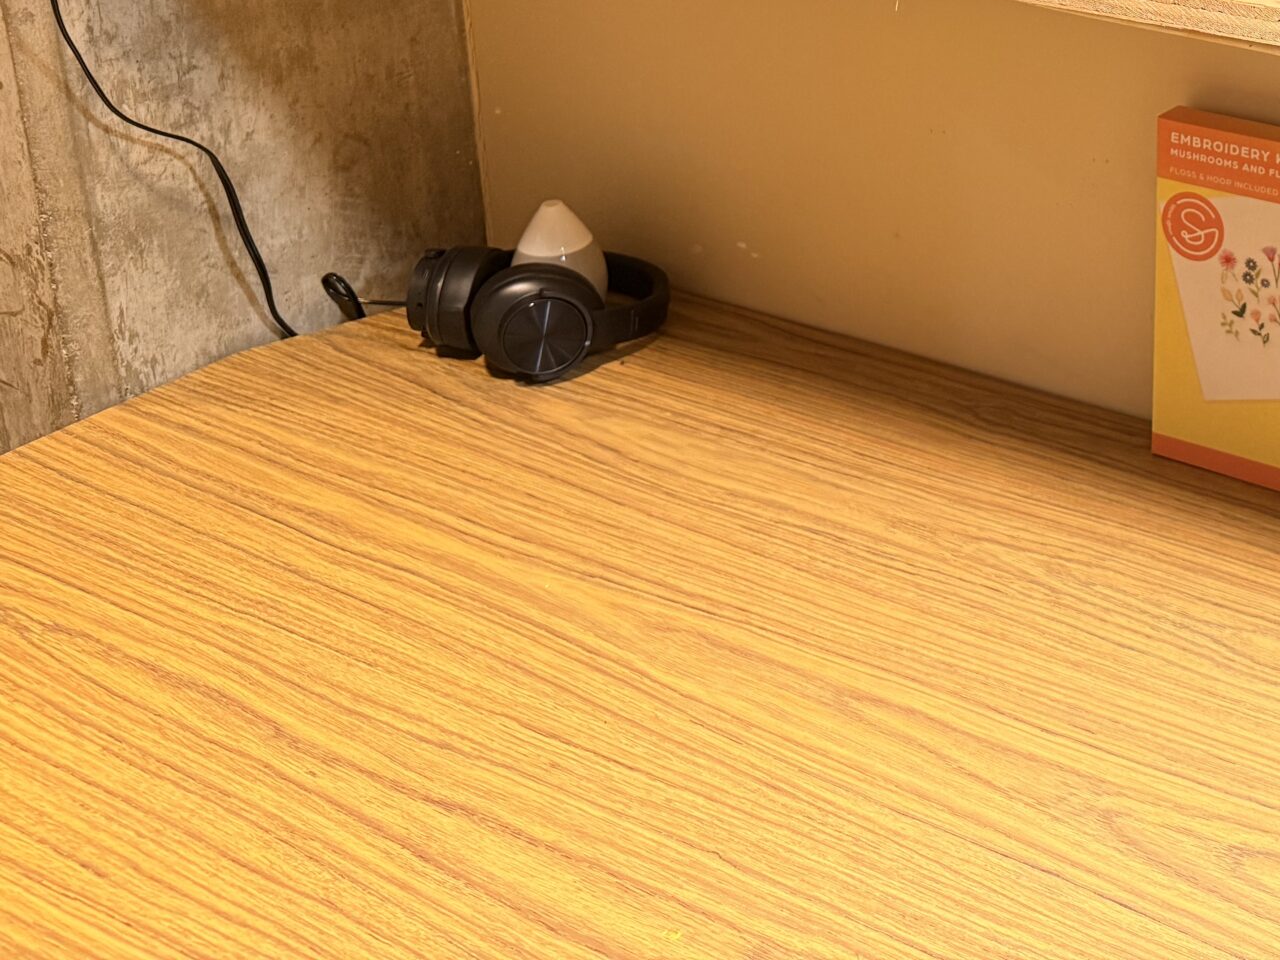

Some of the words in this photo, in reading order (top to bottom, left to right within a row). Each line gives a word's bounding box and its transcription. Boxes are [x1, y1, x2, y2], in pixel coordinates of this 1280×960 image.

[1170, 131, 1271, 163] EMBROIDERY
[1170, 147, 1240, 170] MUSHROOMS
[1241, 163, 1266, 176] AND
[1169, 166, 1198, 180] FLOSS
[1206, 174, 1233, 186] HOOP
[1234, 181, 1279, 197] INCLUDED
